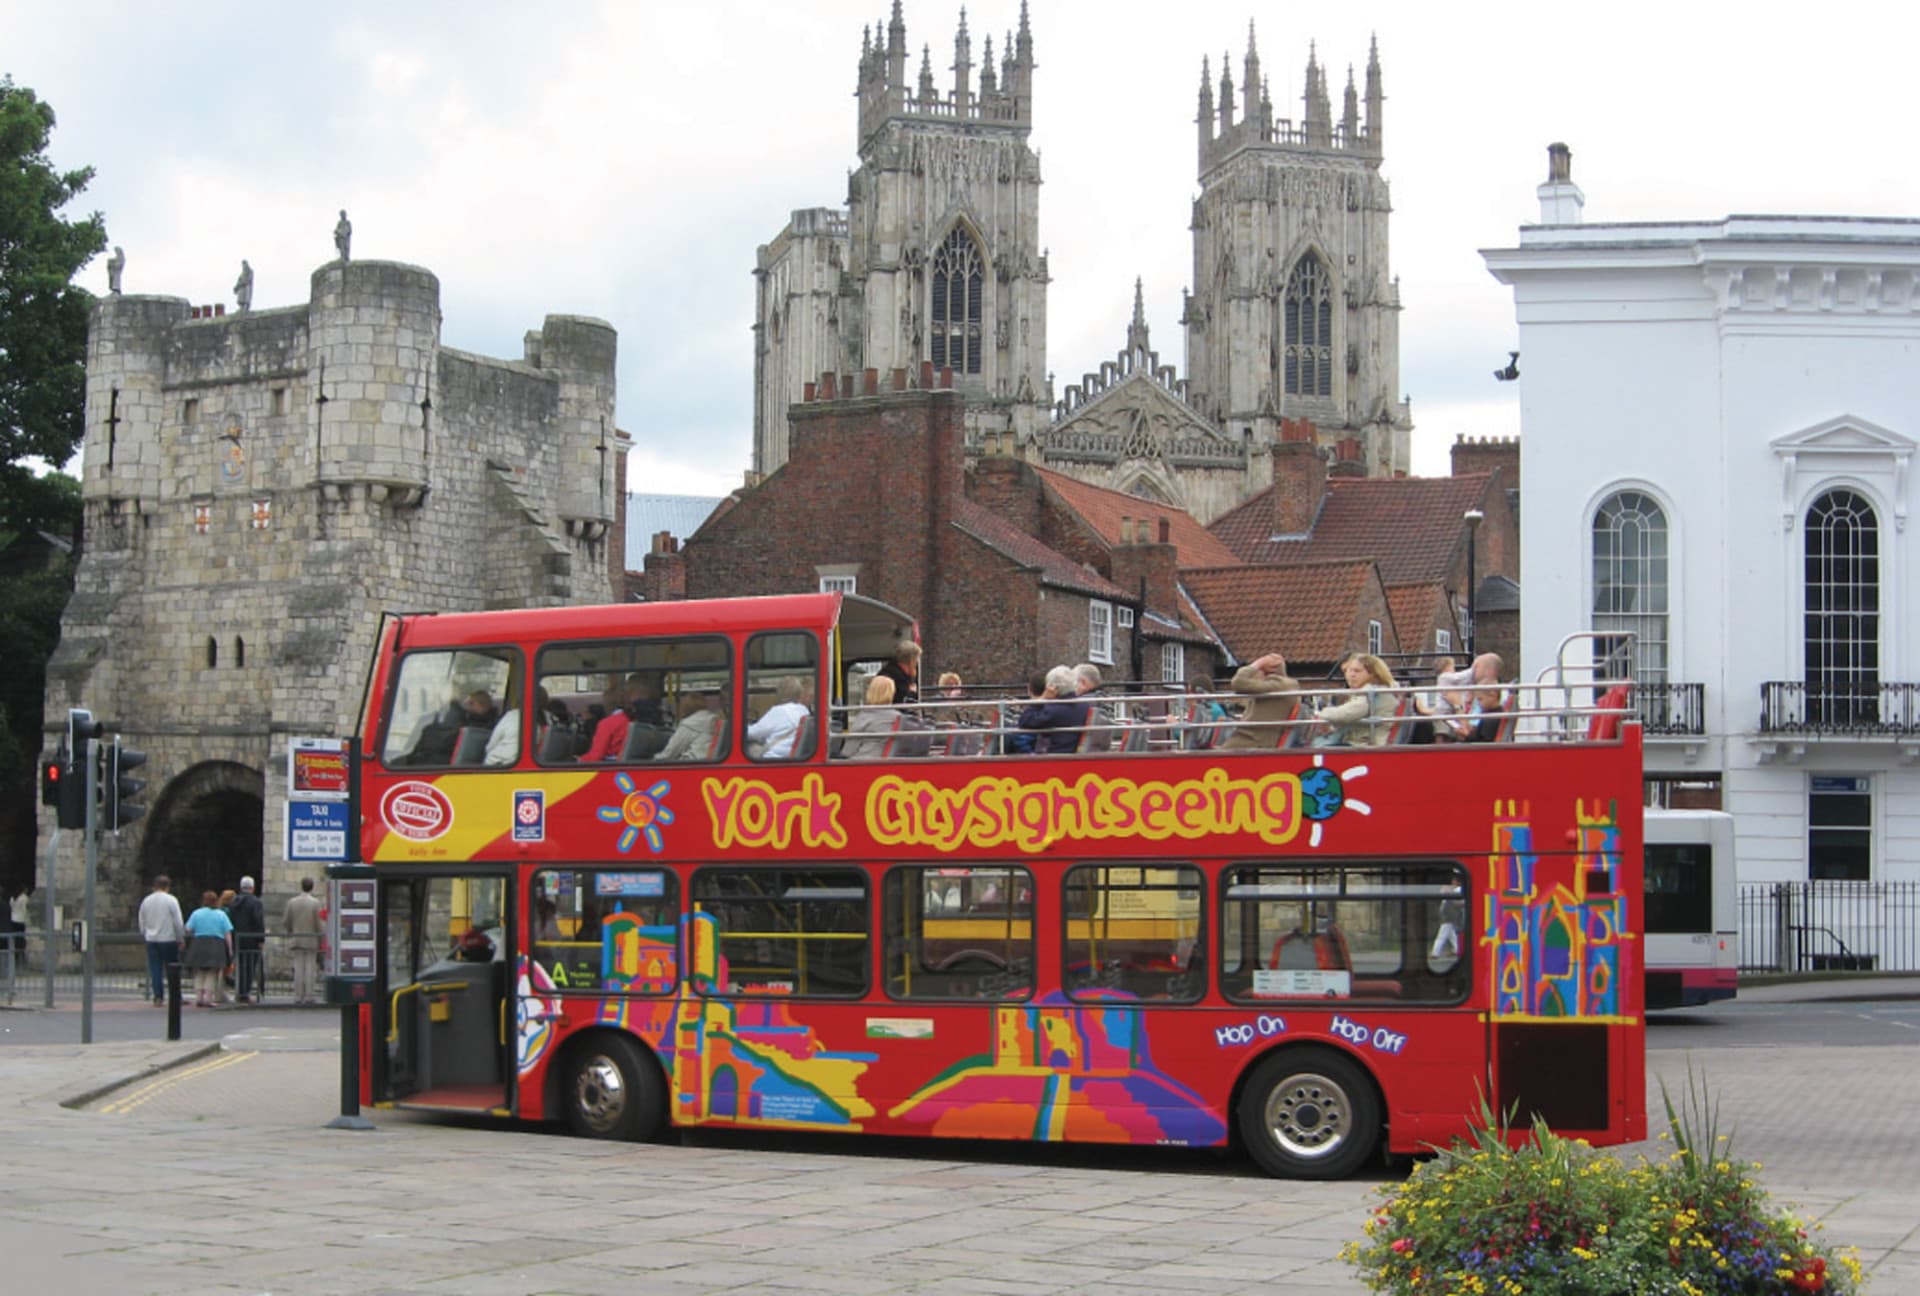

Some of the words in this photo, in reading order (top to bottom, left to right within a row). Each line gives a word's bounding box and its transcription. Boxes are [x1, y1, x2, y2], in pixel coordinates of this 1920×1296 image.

[702, 773, 848, 849] York
[1215, 1022, 1255, 1047] Hop
[1256, 1014, 1286, 1037] On
[1330, 1015, 1369, 1043] Hop
[1371, 1028, 1408, 1055] Off
